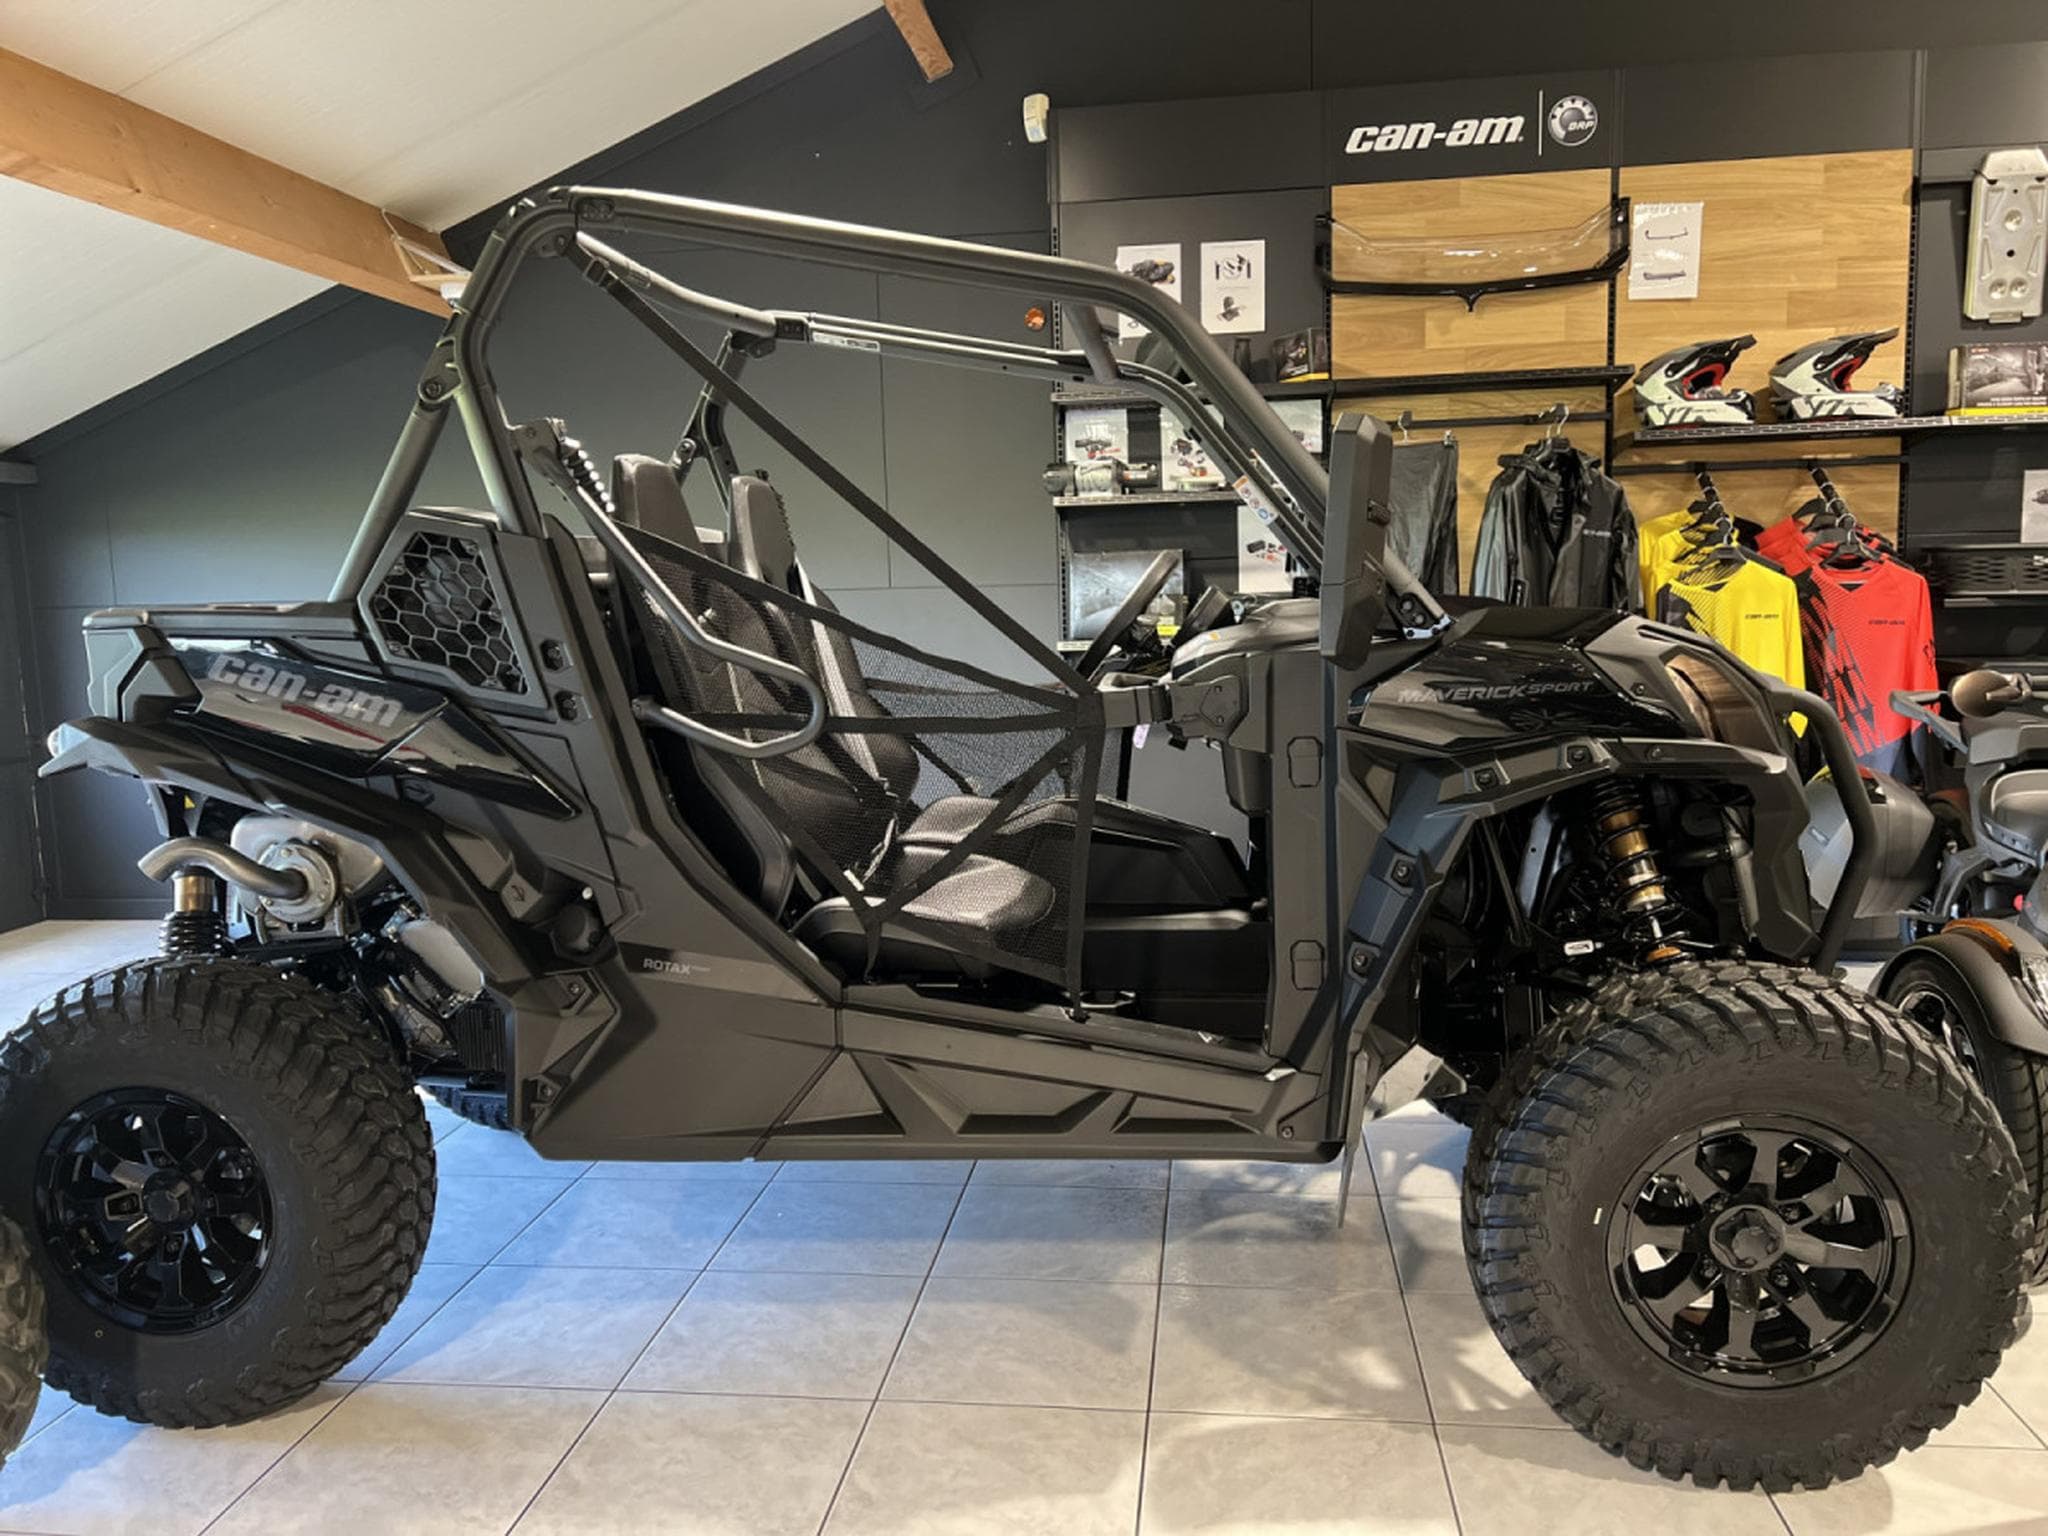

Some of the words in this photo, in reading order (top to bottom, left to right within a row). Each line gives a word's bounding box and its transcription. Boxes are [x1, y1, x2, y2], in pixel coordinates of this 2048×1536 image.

[1345, 115, 1524, 154] can-am
[208, 654, 402, 728] can-am
[1398, 684, 1528, 703] MAVERICK
[1527, 681, 1594, 694] SPORT
[643, 957, 691, 975] ROTAX
